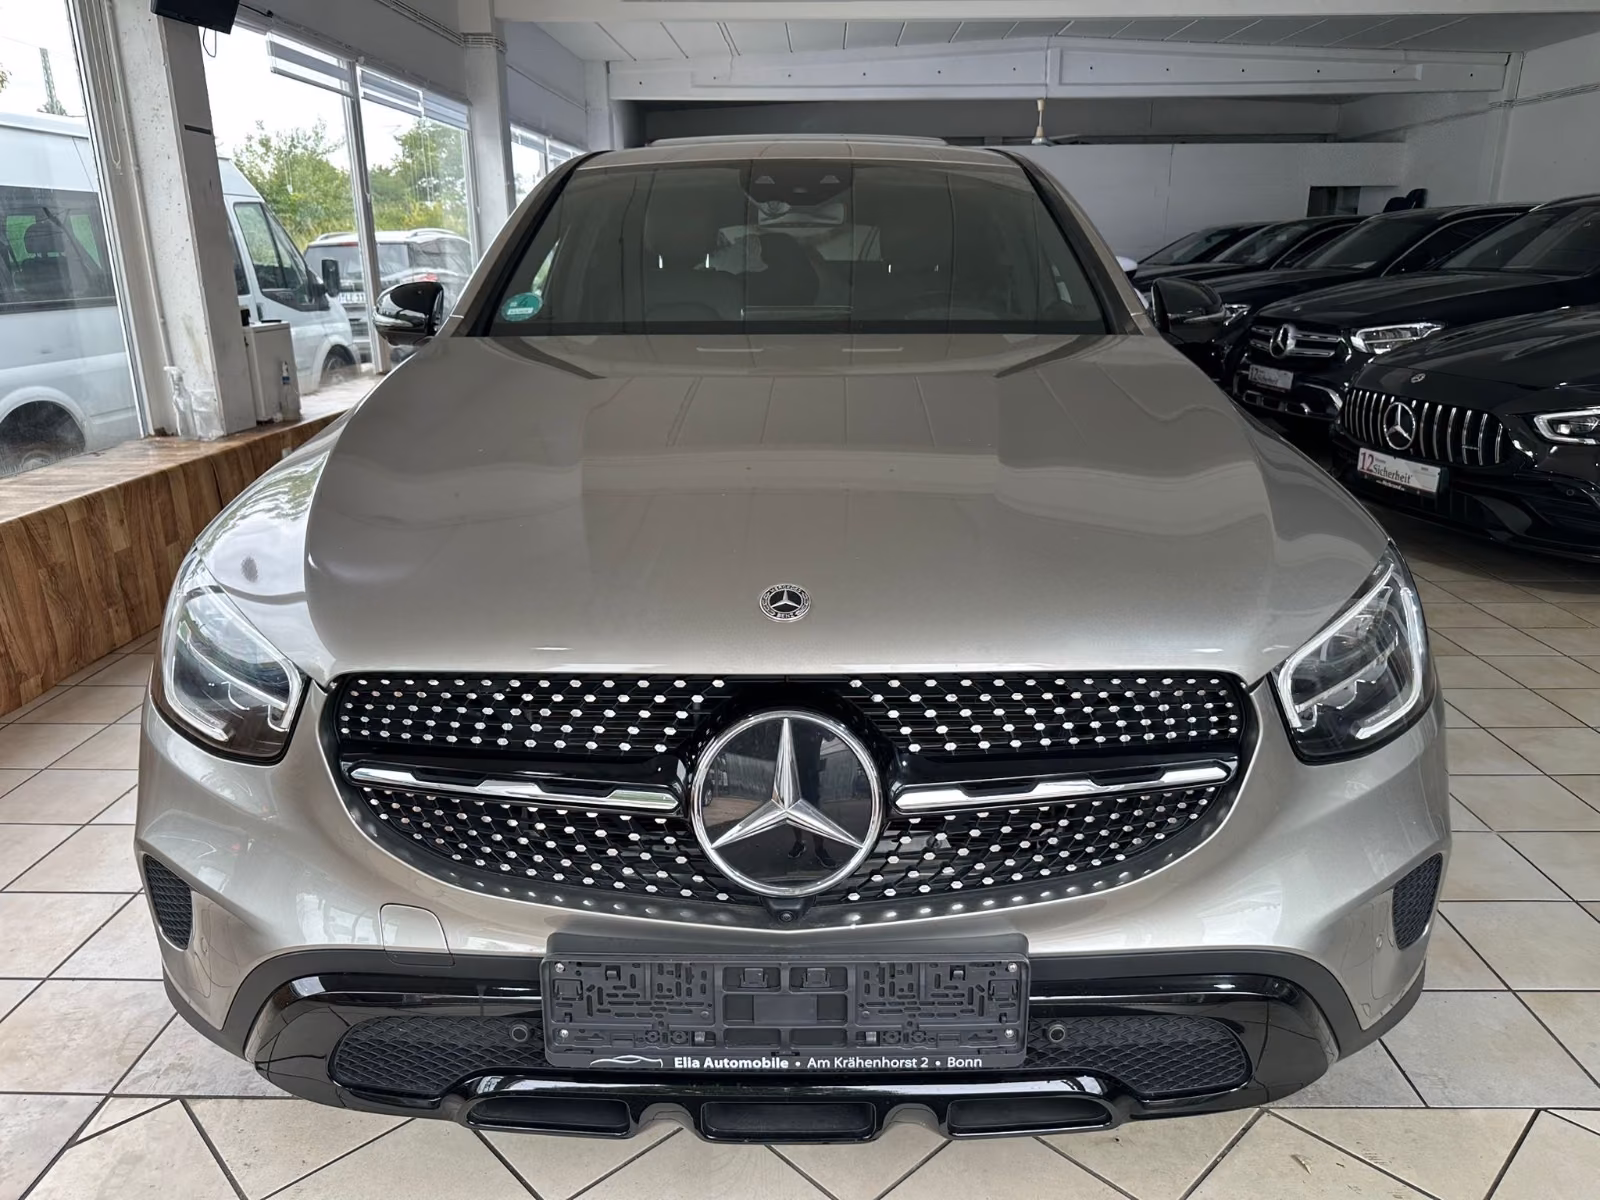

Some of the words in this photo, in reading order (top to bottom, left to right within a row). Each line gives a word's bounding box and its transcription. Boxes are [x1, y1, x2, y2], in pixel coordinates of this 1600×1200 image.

[1360, 452, 1375, 473] 12
[1373, 463, 1412, 484] Sicherheit
[703, 1056, 789, 1069] Automobile
[806, 1057, 831, 1069] Am
[834, 1056, 918, 1069] Krähenhorst
[920, 1057, 929, 1068] 2
[947, 1056, 983, 1068] Bonn
